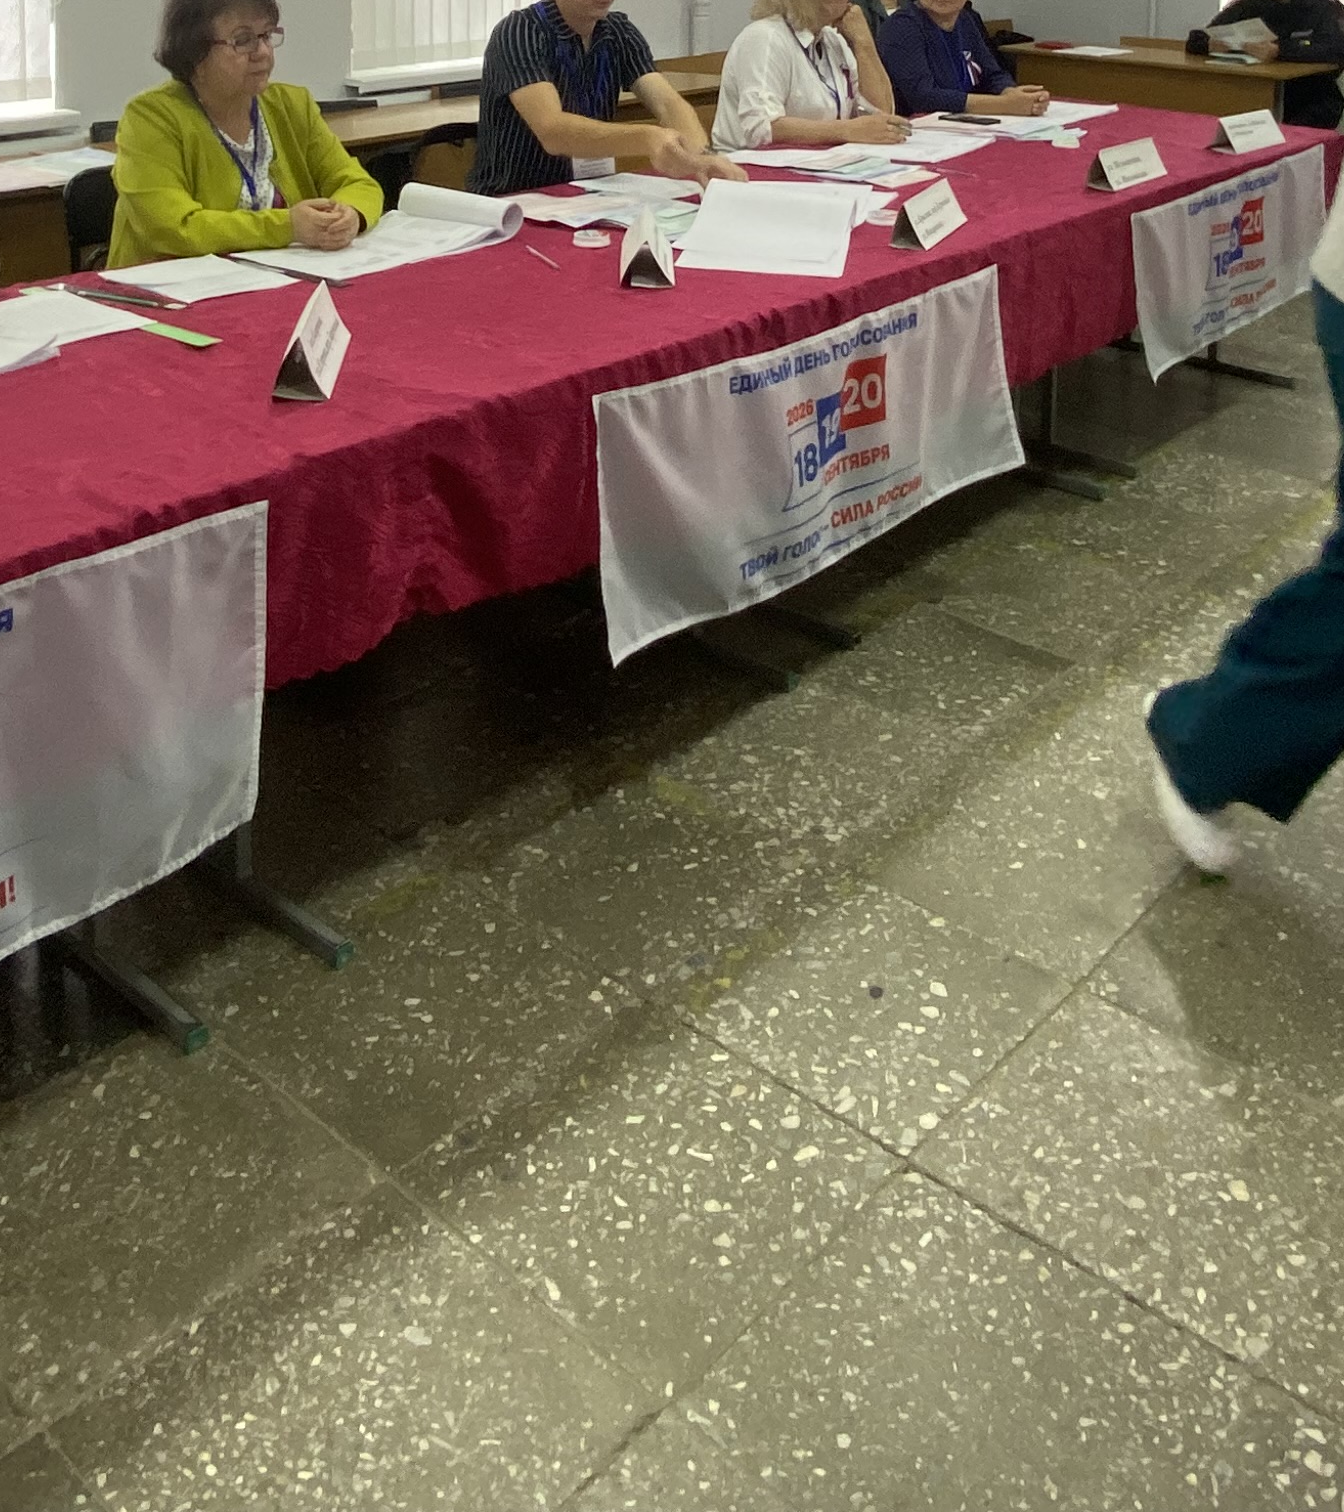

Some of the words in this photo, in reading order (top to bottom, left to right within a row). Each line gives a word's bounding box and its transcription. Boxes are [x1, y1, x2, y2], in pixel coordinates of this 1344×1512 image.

[729, 357, 792, 395] ЕДИНЫЙ
[794, 350, 831, 376] ДЕНЬ
[786, 398, 814, 427] 2026
[795, 443, 818, 487] 18
[843, 373, 883, 415] 20
[740, 546, 779, 580] ТВОЙ
[783, 530, 822, 561] ГОЛО
[831, 499, 874, 528] СИЛА
